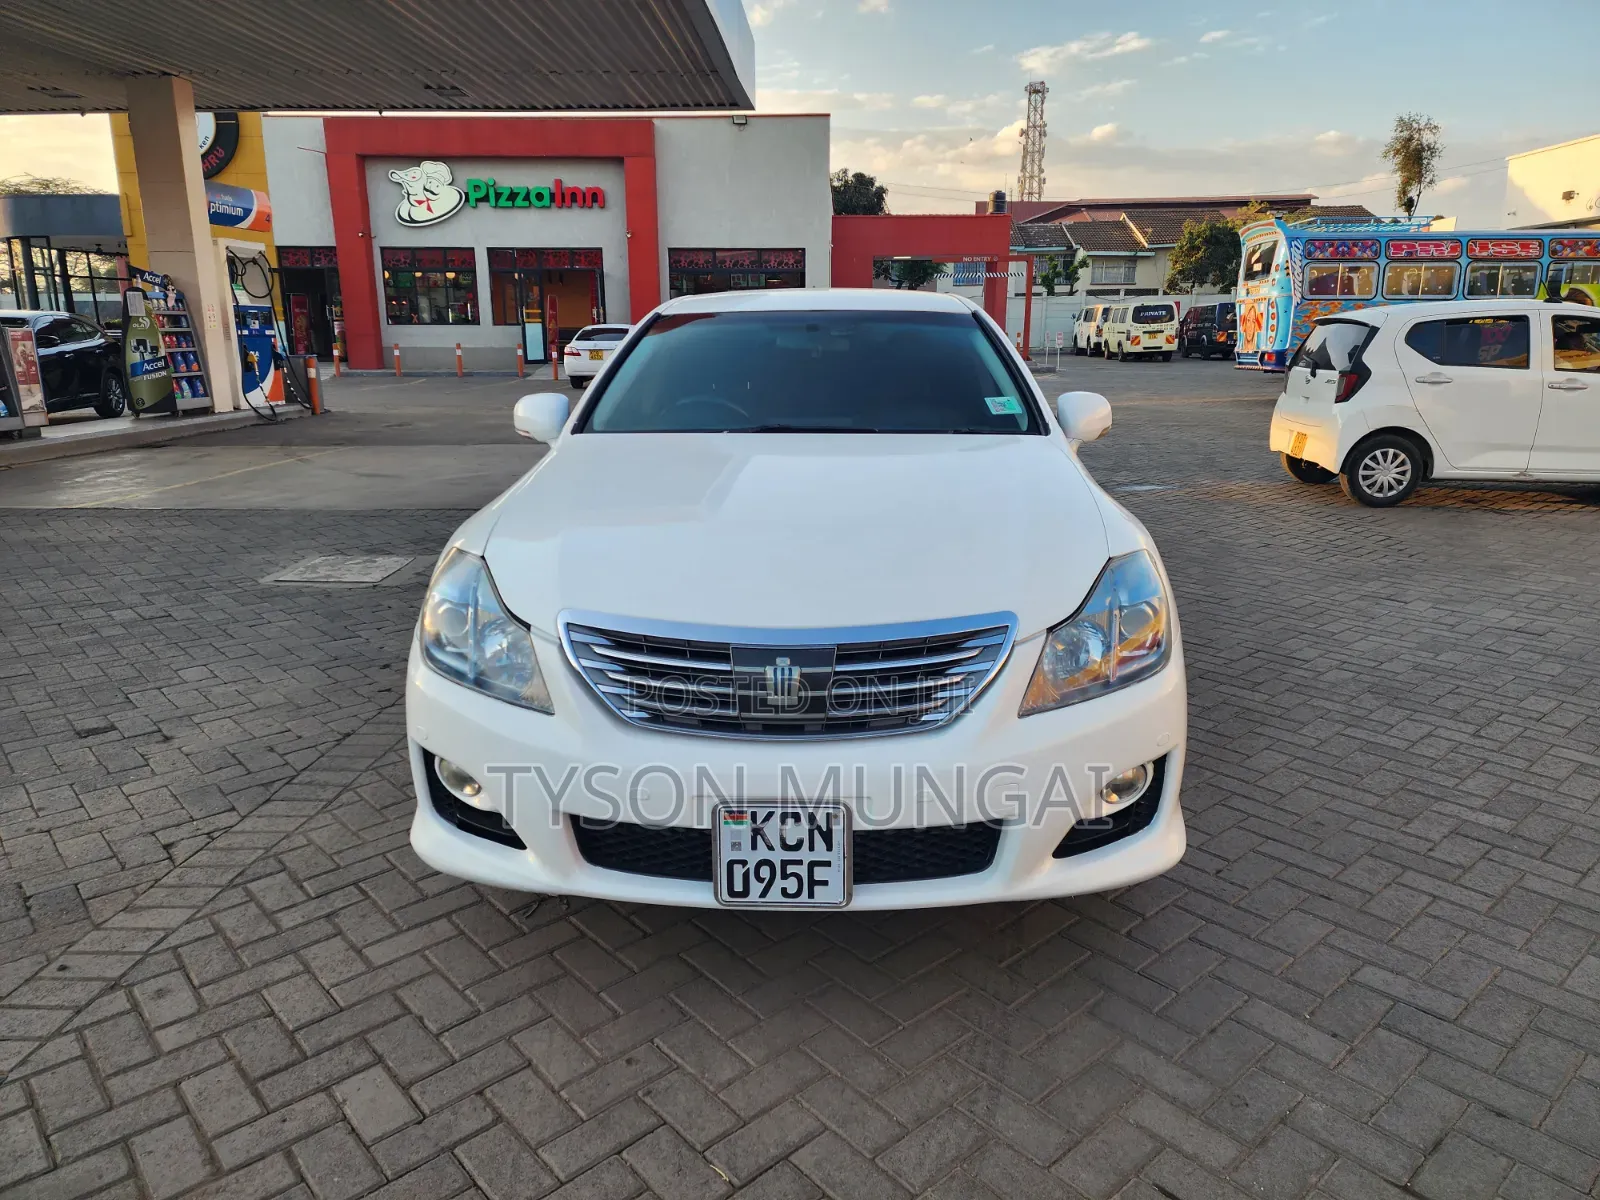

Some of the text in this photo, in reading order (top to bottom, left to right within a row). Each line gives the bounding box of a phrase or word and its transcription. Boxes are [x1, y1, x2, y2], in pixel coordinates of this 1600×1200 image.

[199, 135, 210, 150] ken
[202, 147, 225, 172] HRU
[466, 178, 605, 208] Pizza Inn
[209, 201, 244, 216] ptimium
[143, 272, 162, 285] Accel
[142, 360, 165, 373] Accel
[143, 370, 168, 381] FUSION
[750, 811, 833, 852] KCN
[726, 859, 832, 899] 095F
